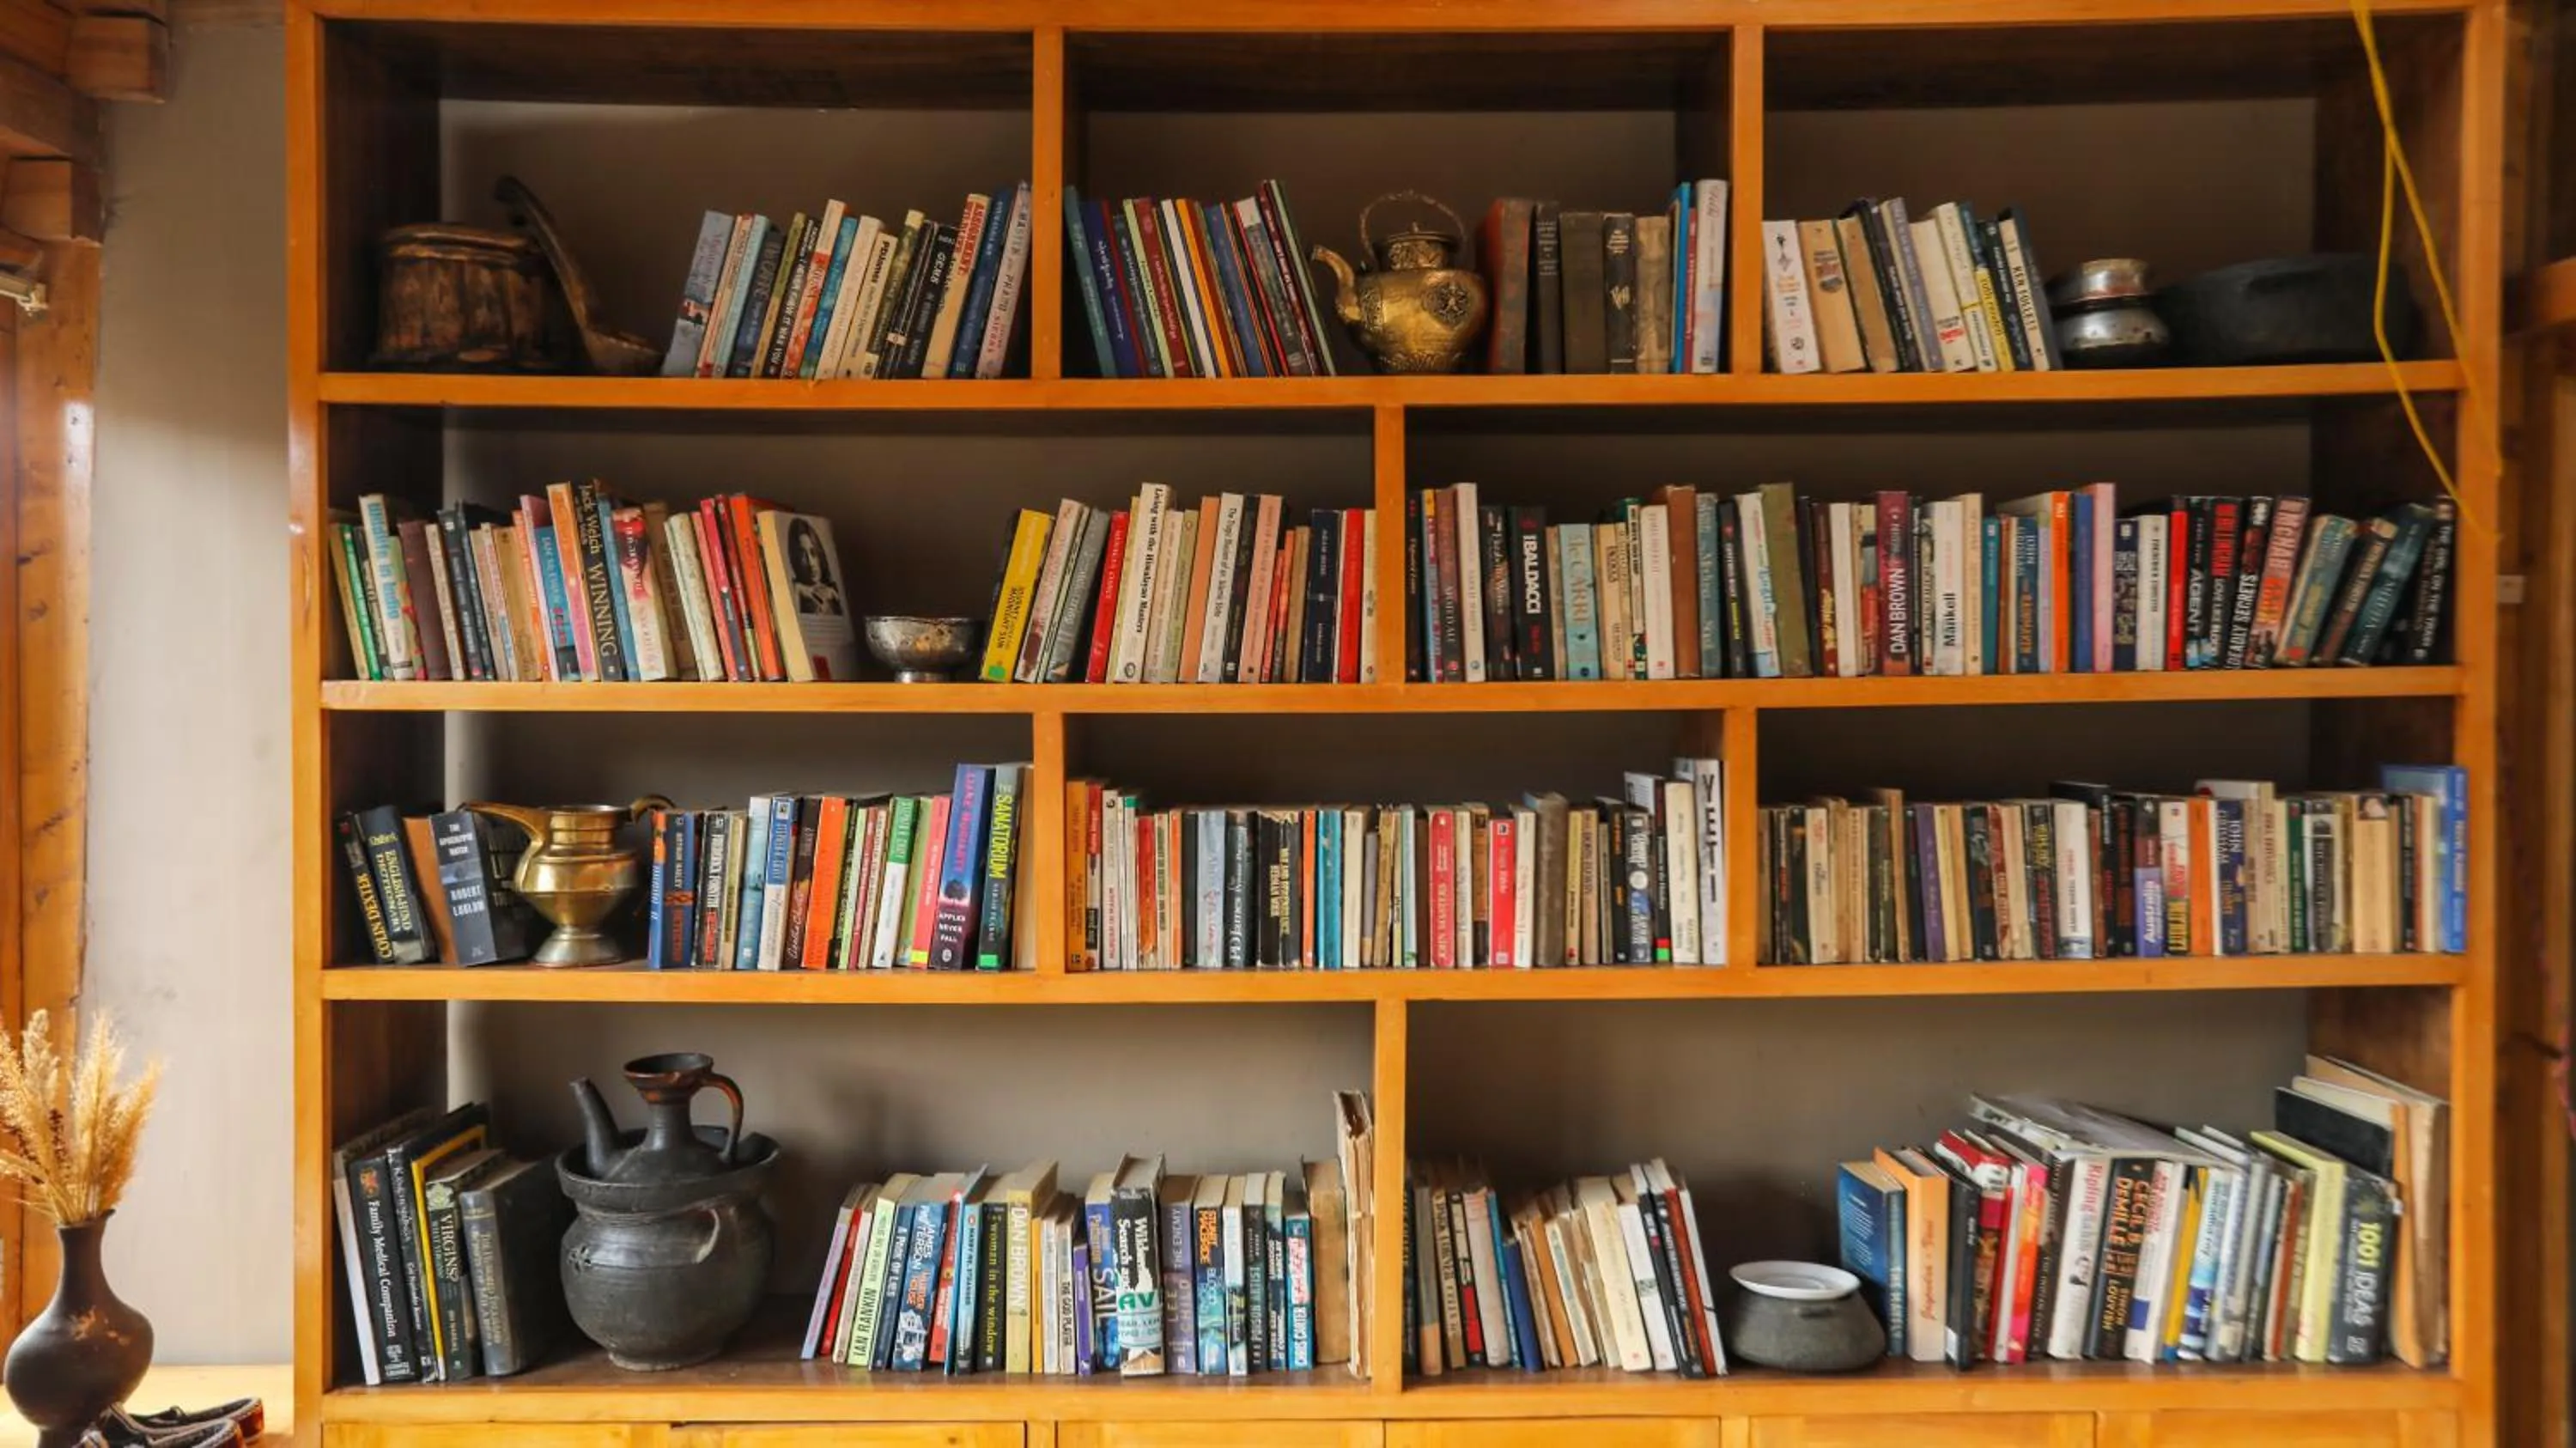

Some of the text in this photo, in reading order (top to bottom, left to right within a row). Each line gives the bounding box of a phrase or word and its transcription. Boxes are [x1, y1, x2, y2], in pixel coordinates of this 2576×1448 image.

[769, 345, 783, 364] YOU
[1148, 515, 1160, 535] with
[1150, 487, 1164, 514] Living
[366, 502, 401, 620] Wildlife in India
[578, 484, 619, 663] Jack Welch WINNING
[1138, 552, 1155, 598] Himalayan
[2026, 534, 2035, 564] JOHN
[1522, 538, 1540, 614] BALDACCI
[2186, 567, 2202, 634] AGENT
[2213, 576, 2224, 600] LOVE
[2235, 573, 2257, 624] SECRETS
[1133, 600, 1148, 633] Masters
[1890, 567, 1905, 653] DAN BROWN
[960, 772, 977, 809] LIANE
[984, 792, 1016, 879] SANATORIUM
[1702, 774, 1720, 903] YETI
[2229, 820, 2242, 853] JOHN
[355, 870, 393, 959] COLIN DEXTER
[2142, 879, 2156, 943] Australia
[2081, 1164, 2104, 1213] Kipling
[2124, 1179, 2150, 1247] CECIL B.
[438, 1214, 459, 1282] VIRGINS?
[897, 1225, 908, 1233] A
[908, 1203, 933, 1271] PATTERSON
[921, 1225, 938, 1259] JAMES
[1115, 1217, 1133, 1264] Search
[1170, 1208, 1183, 1268] THE ENEMY
[1198, 1209, 1211, 1263] MACBRIDE
[1208, 1209, 1218, 1245] STUART
[364, 1200, 400, 1338] Family Medical Companion
[890, 1261, 903, 1275] OF
[1009, 1207, 1029, 1306] DAN BROWN
[2348, 1220, 2384, 1328] 1001 IDEAS
[884, 1275, 900, 1298] LIES
[904, 1272, 921, 1306] HOUSE
[912, 1269, 932, 1311] MURDER
[985, 1225, 1000, 1351] woman in the window
[1061, 1281, 1071, 1295] THE
[1092, 1267, 1117, 1327] SAIL
[1168, 1287, 1178, 1323] LEE
[1249, 1265, 1263, 1341] POISON ARTIST
[853, 1287, 878, 1357] IAN RANKIN
